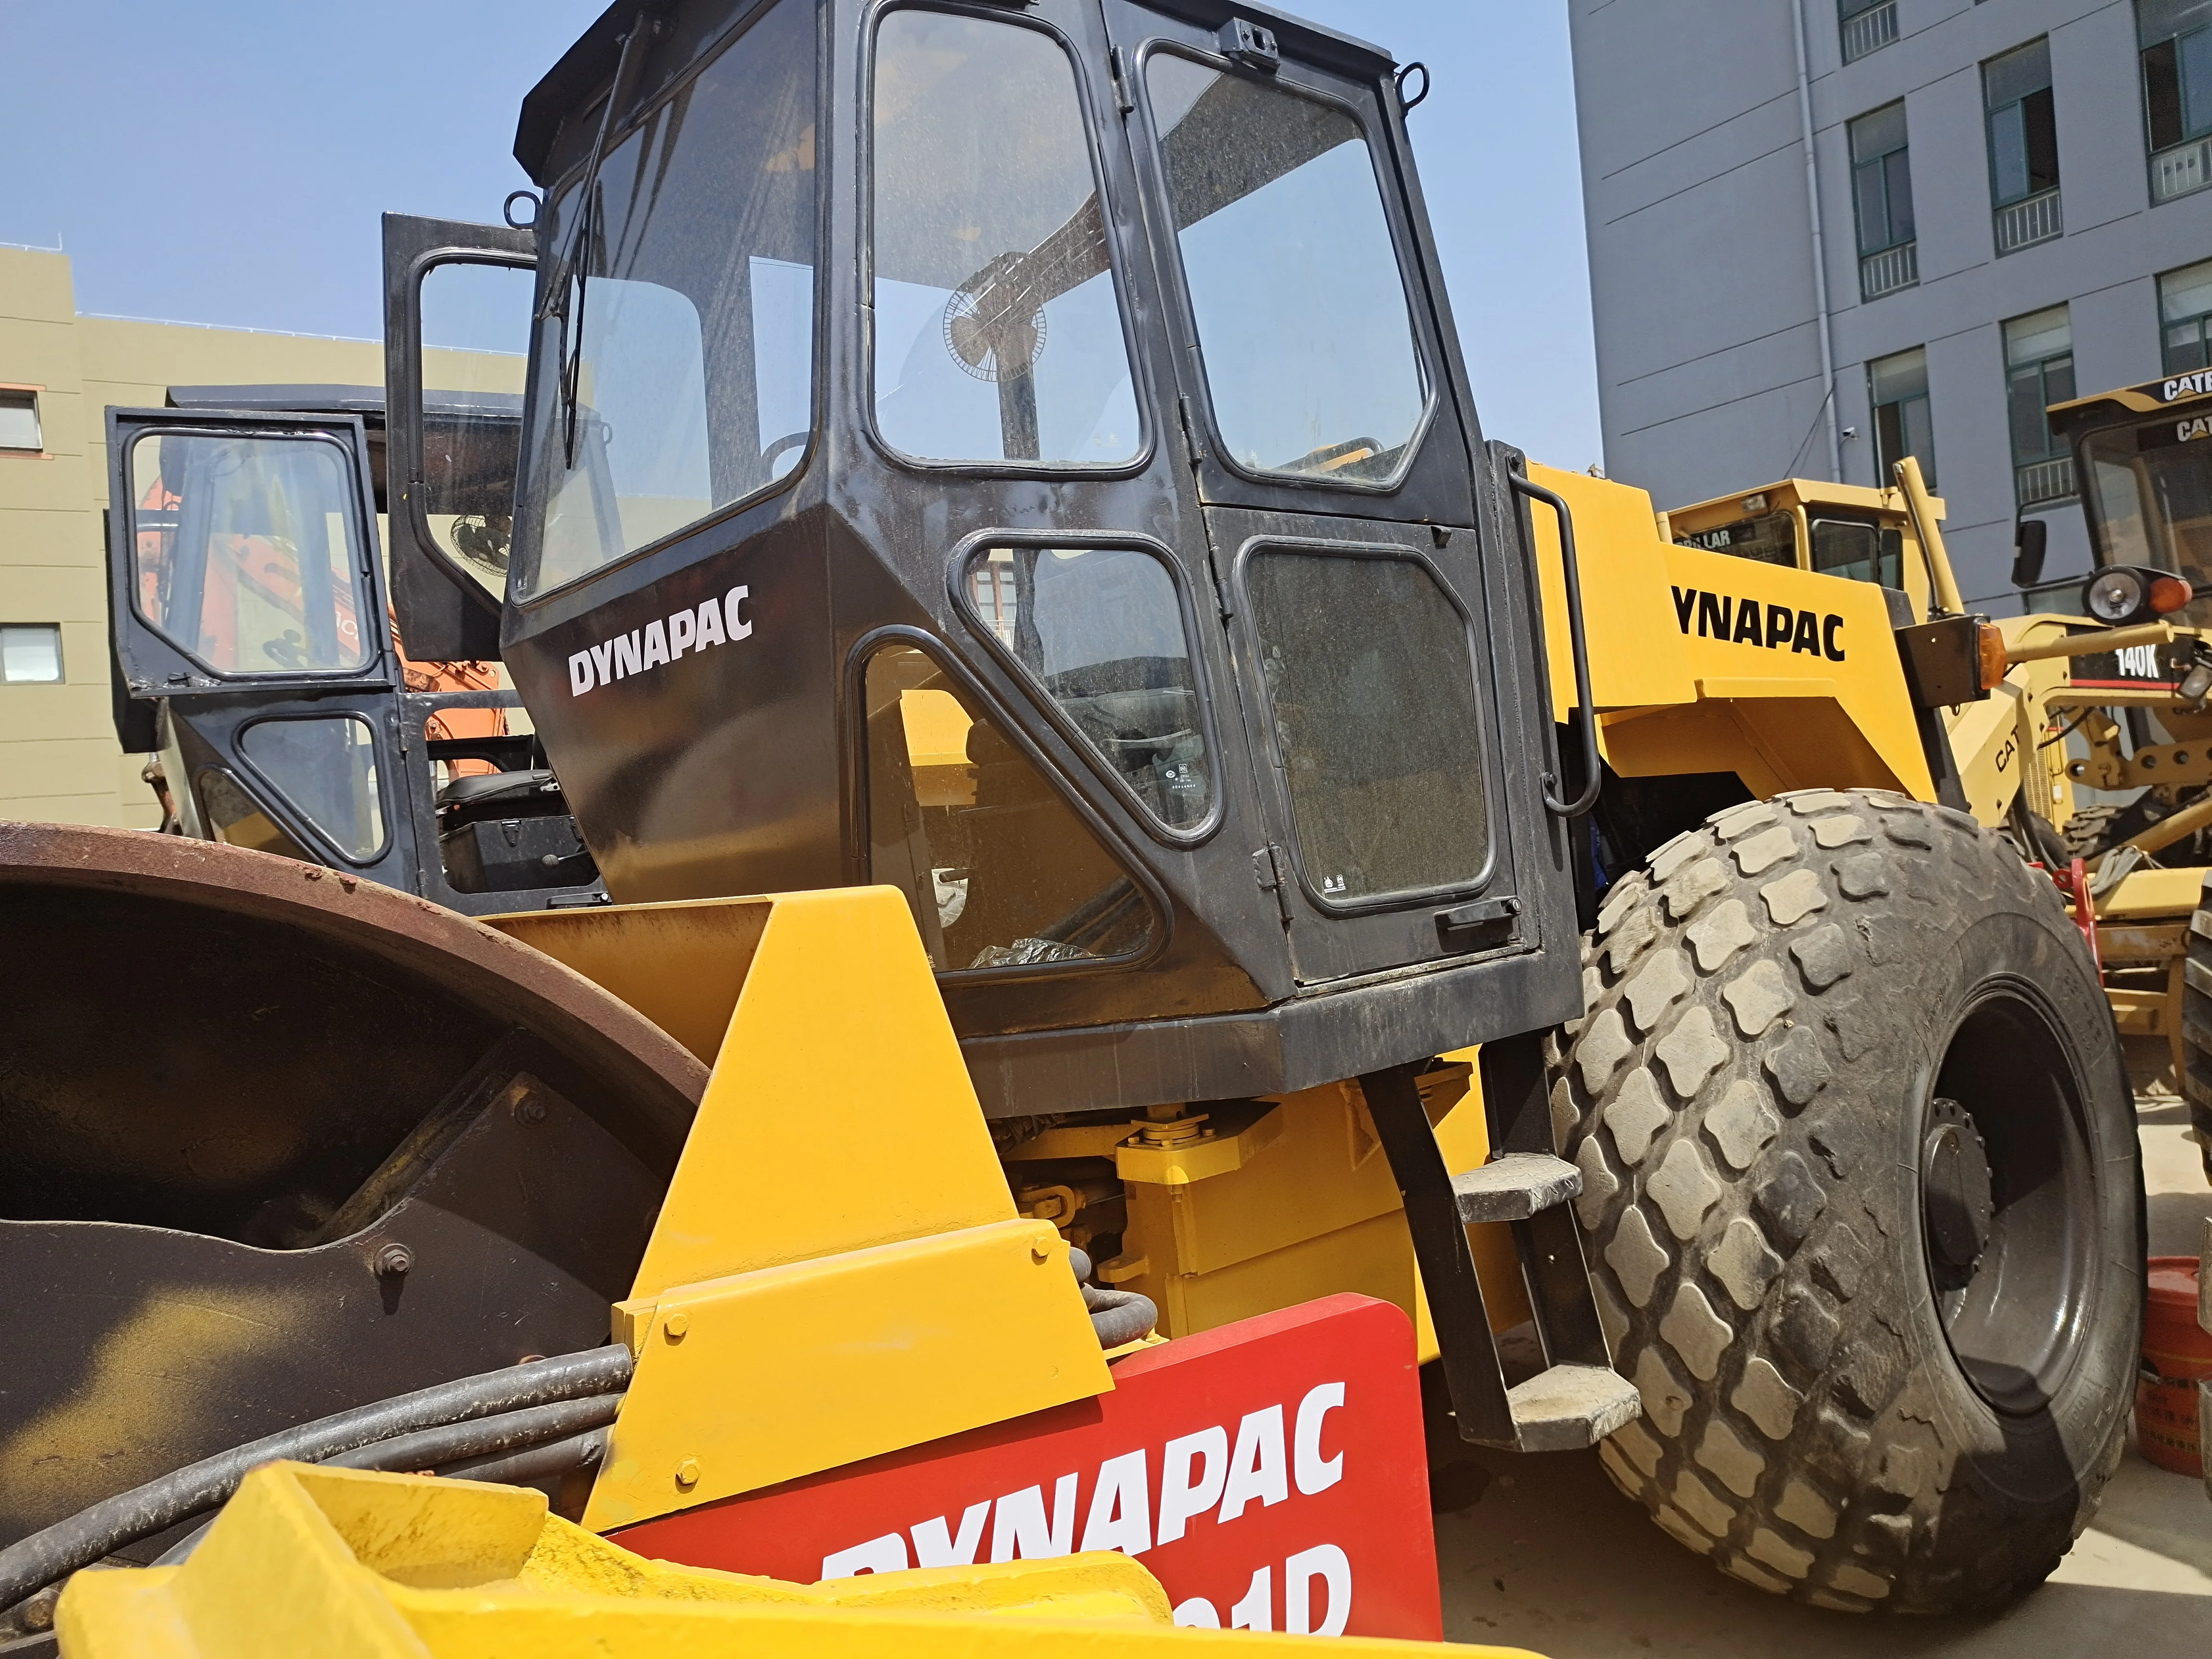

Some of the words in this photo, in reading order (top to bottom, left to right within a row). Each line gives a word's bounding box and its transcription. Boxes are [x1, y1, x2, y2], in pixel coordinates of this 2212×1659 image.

[568, 585, 752, 697] DYNAPAC
[2115, 644, 2159, 678] 140K
[1996, 723, 2020, 773] CAT
